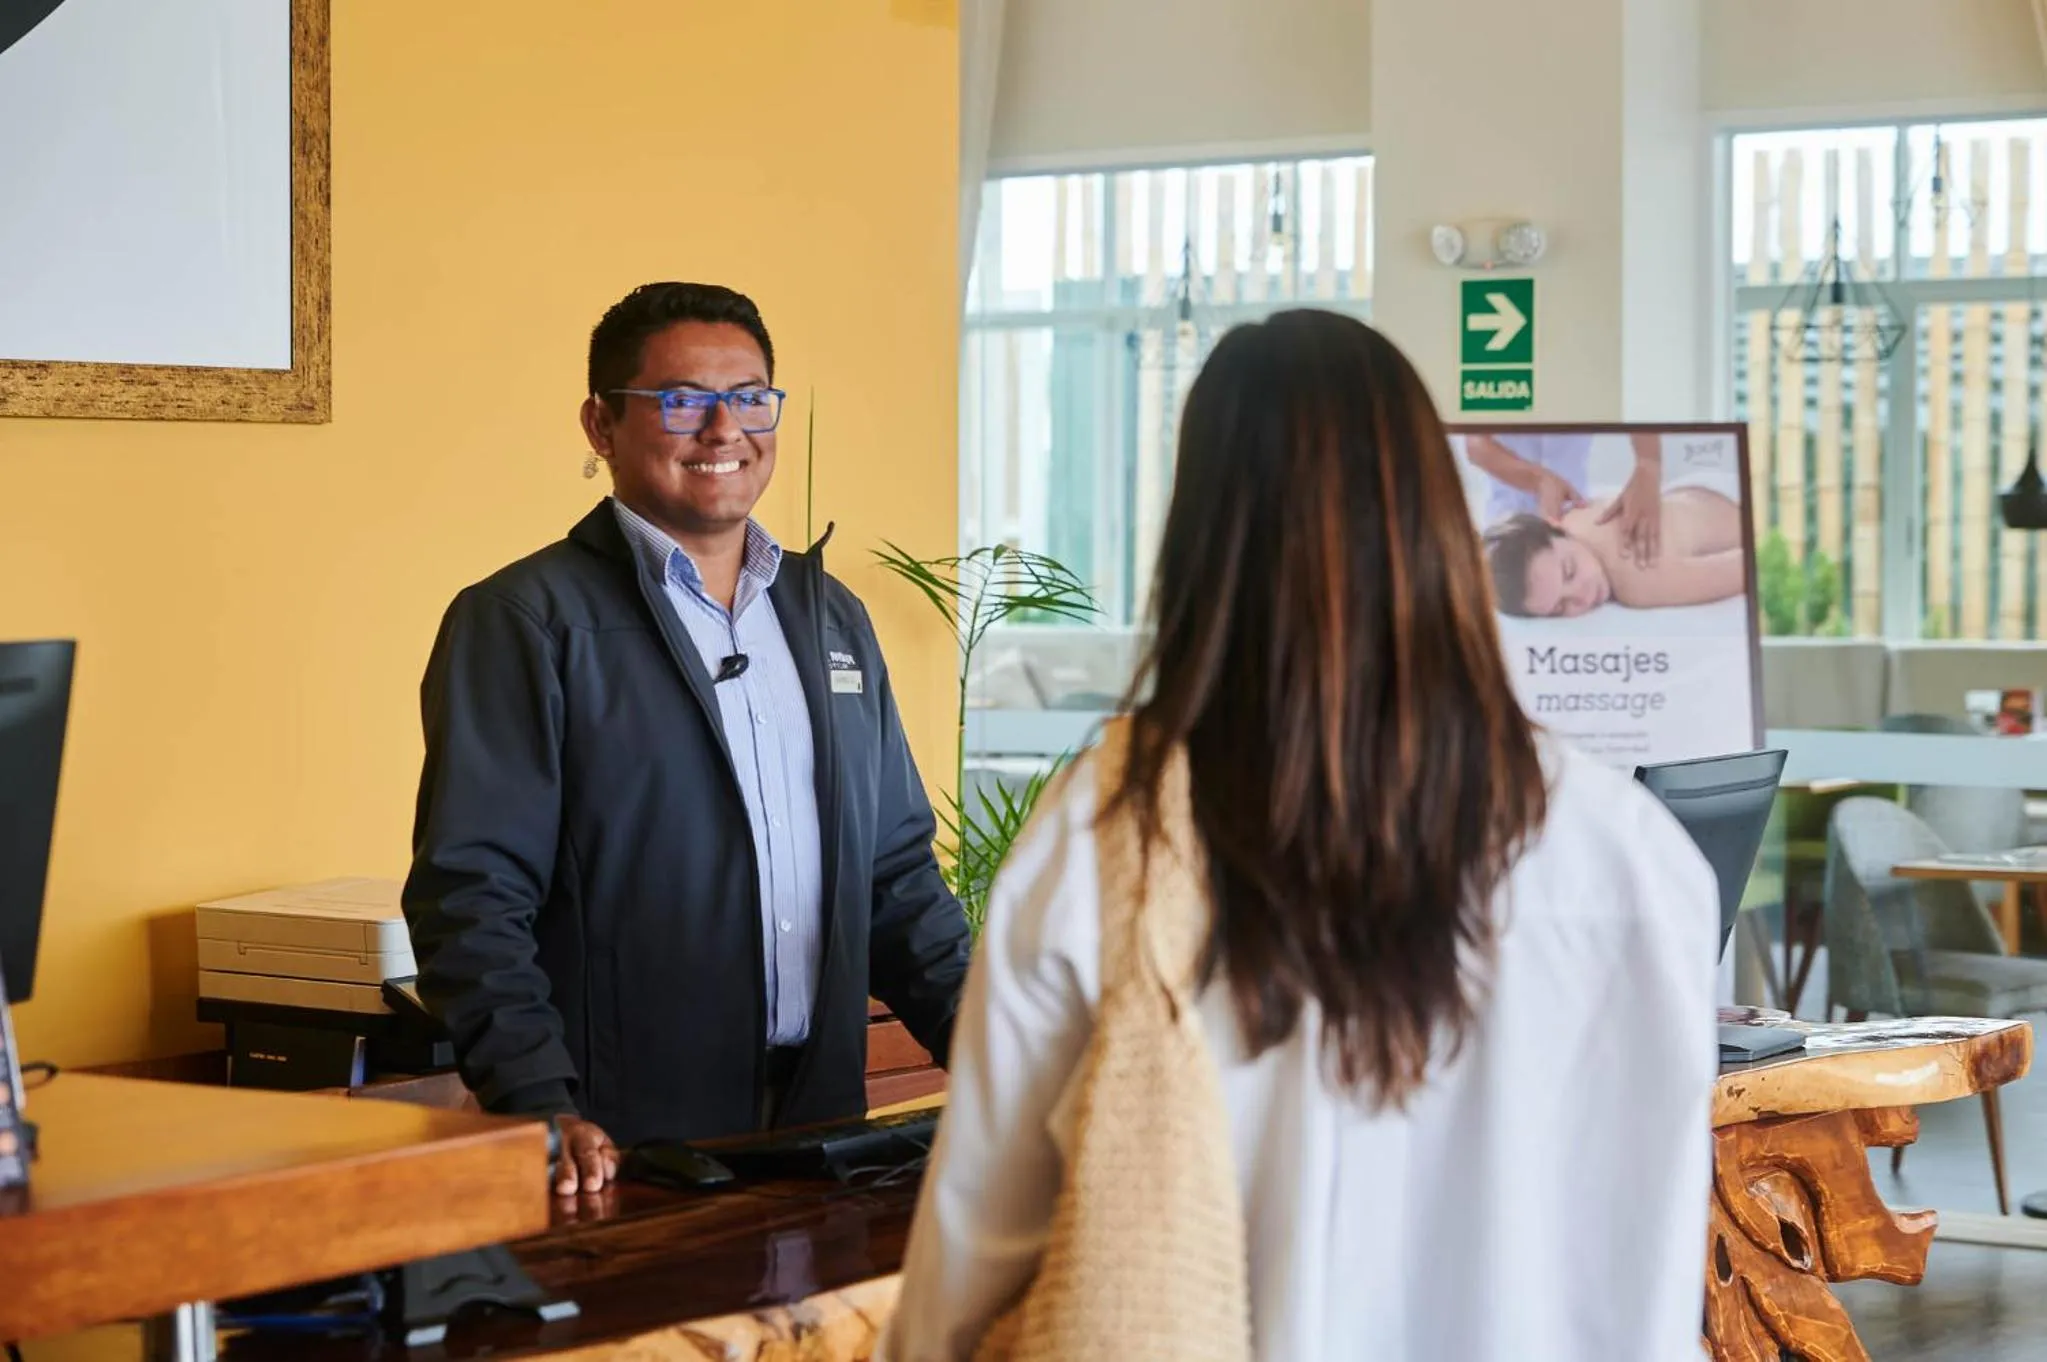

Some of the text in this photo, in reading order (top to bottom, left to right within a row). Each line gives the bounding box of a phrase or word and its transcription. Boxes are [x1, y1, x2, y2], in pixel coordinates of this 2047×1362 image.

[1463, 381, 1530, 400] SALIDA
[1526, 645, 1670, 683] Masajes
[1536, 690, 1666, 718] massage
